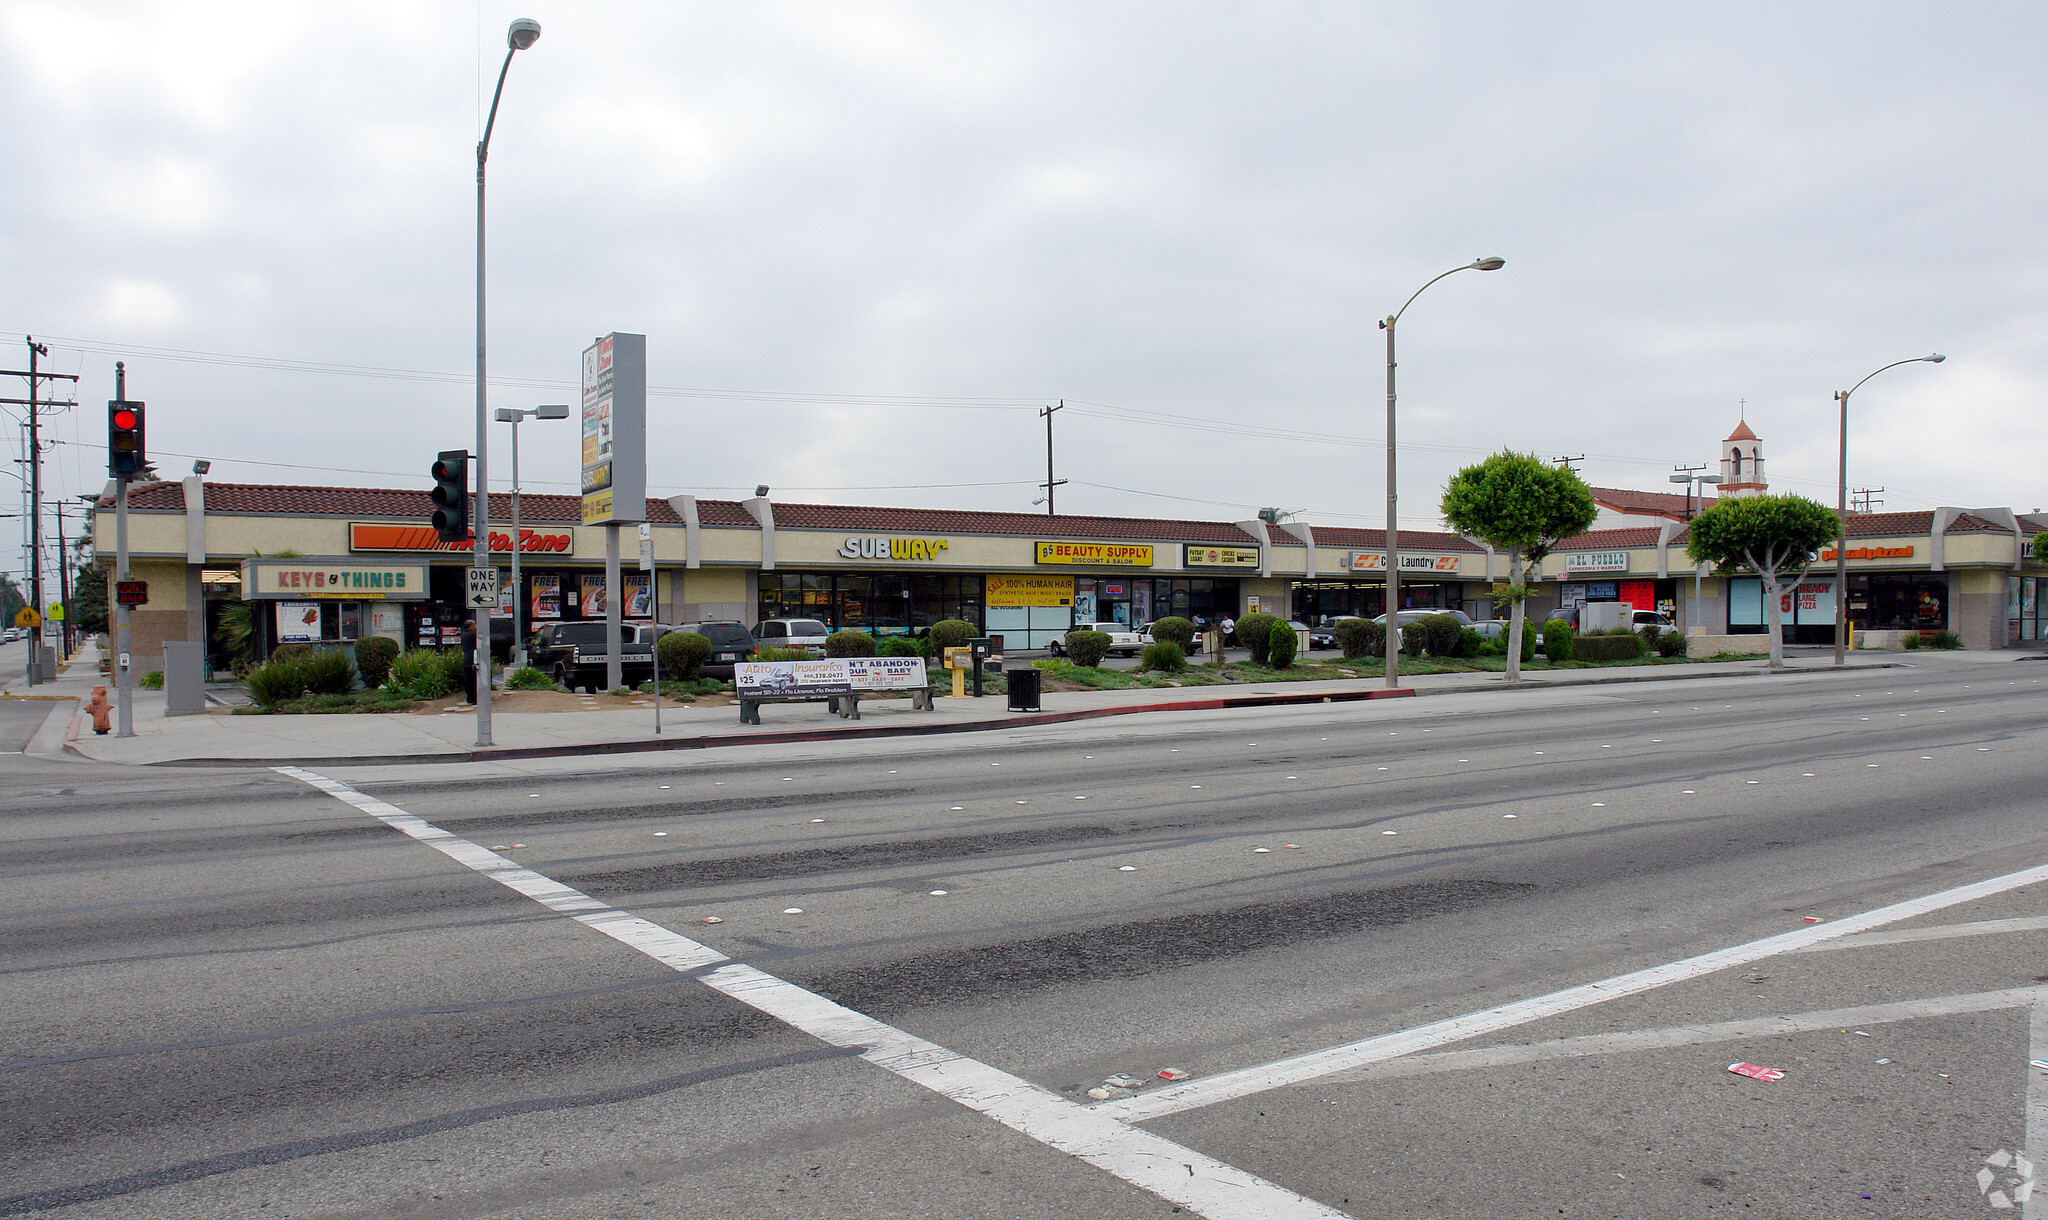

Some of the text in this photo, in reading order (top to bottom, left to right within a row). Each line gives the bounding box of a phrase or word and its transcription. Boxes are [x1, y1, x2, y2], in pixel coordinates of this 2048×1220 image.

[450, 529, 571, 552] AtoZone
[838, 537, 949, 559] SUBWAY
[1056, 545, 1103, 557] BEAUTY
[1106, 546, 1148, 558] SUPPLY
[1401, 556, 1435, 569] Laundry
[1576, 553, 1624, 566] EL PUEBLO
[278, 571, 406, 588] KEYS & THINGS
[470, 570, 495, 580] ONE
[533, 576, 558, 586] FREE
[582, 576, 607, 586] FREE
[625, 576, 650, 586] FREE
[1006, 580, 1073, 589] 100% HUMAN HAIR
[470, 582, 496, 592] WAY
[987, 578, 1005, 595] SALE
[1799, 583, 1832, 593] READY
[119, 593, 146, 603] WALK
[744, 662, 843, 674] Auto Insurance
[739, 676, 755, 684] $25
